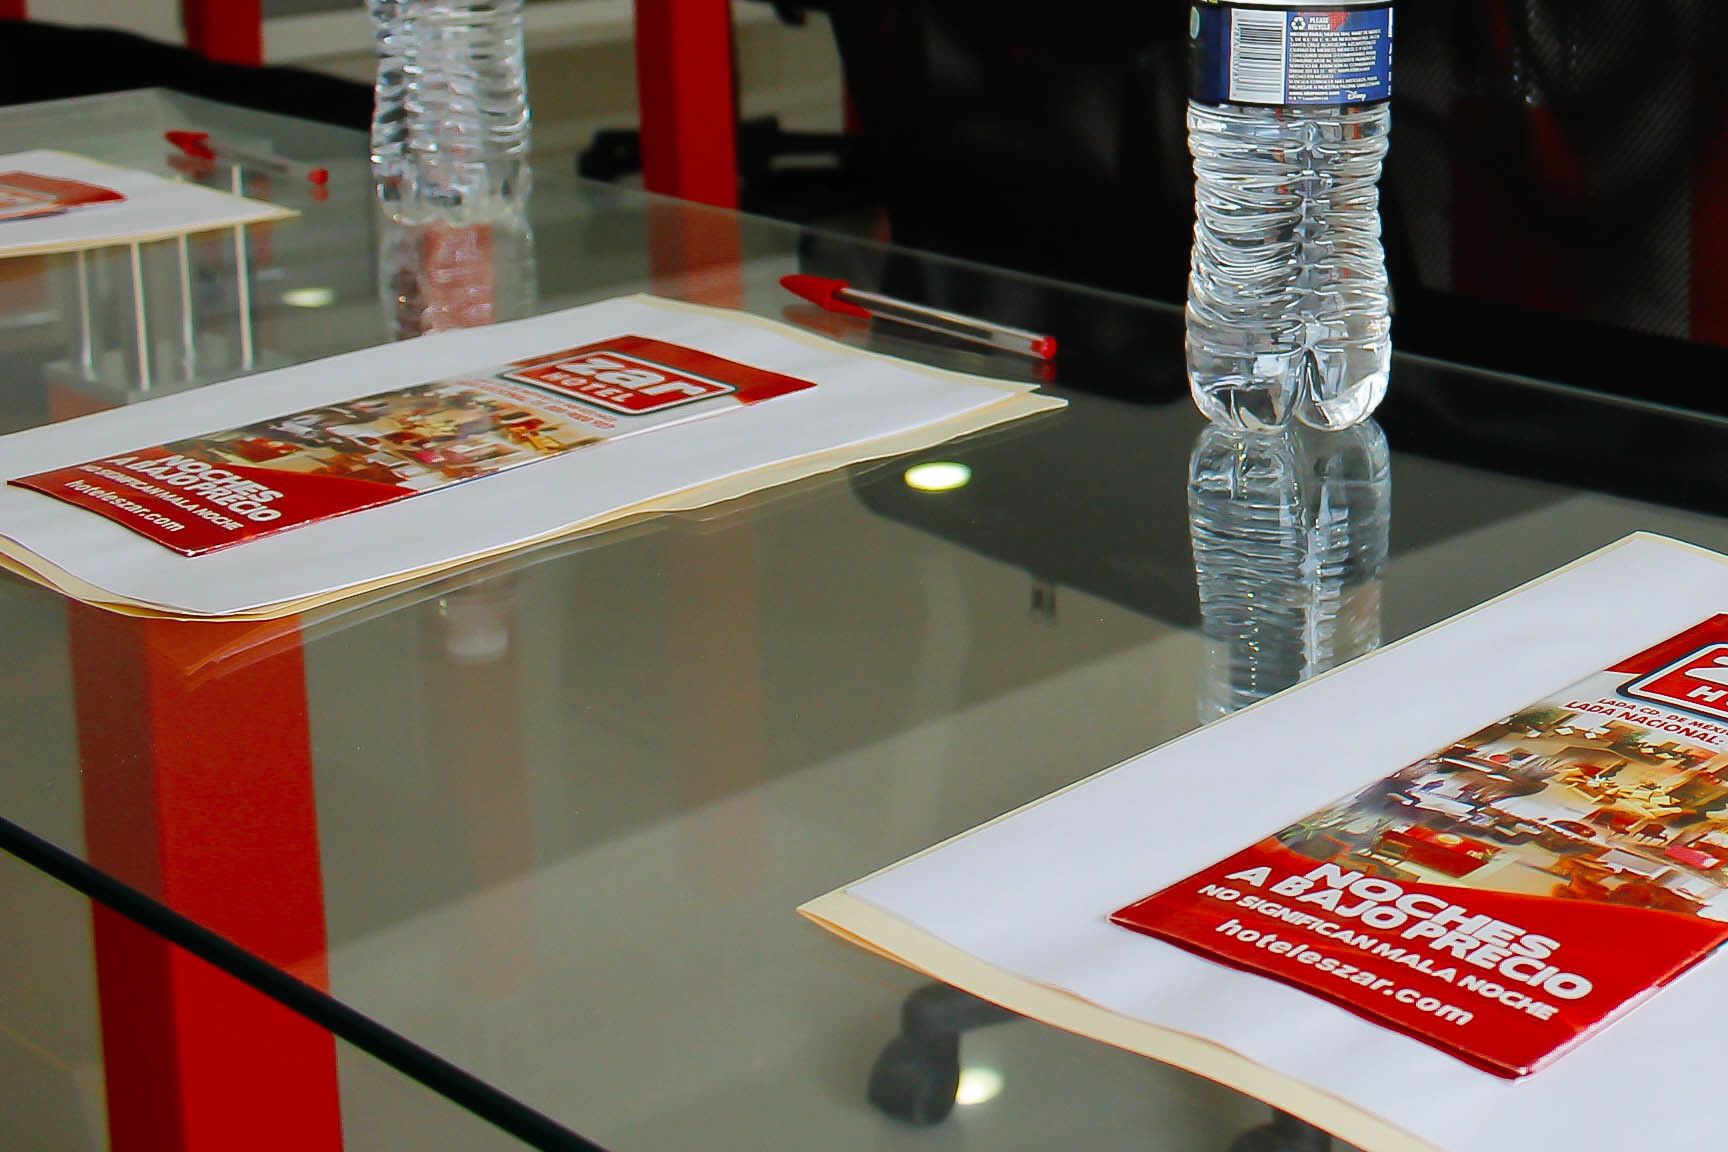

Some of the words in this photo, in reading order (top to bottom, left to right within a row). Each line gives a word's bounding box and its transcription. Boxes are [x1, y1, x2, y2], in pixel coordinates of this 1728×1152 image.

[540, 372, 634, 403] HOTEL
[556, 358, 707, 397] zar
[150, 454, 284, 503] NOCHES
[183, 481, 282, 522] PRECIO
[63, 479, 186, 532] hoteleszar.com
[1565, 700, 1617, 716] LADA
[1616, 711, 1724, 745] NACIONAL:
[1599, 698, 1637, 711] LADA
[1639, 707, 1661, 717] CD.
[1666, 714, 1688, 723] DE
[1225, 866, 1273, 888] A
[1269, 874, 1409, 930] BAJO
[1400, 919, 1594, 1000] PRECIO
[1303, 862, 1561, 960] NOCHES
[1197, 884, 1241, 901] NO
[1235, 895, 1379, 950] SIGNIFICAN
[1371, 942, 1458, 983] MALA
[1456, 974, 1560, 1021] NOCHE
[1215, 918, 1475, 1026] hoteleszar.com
